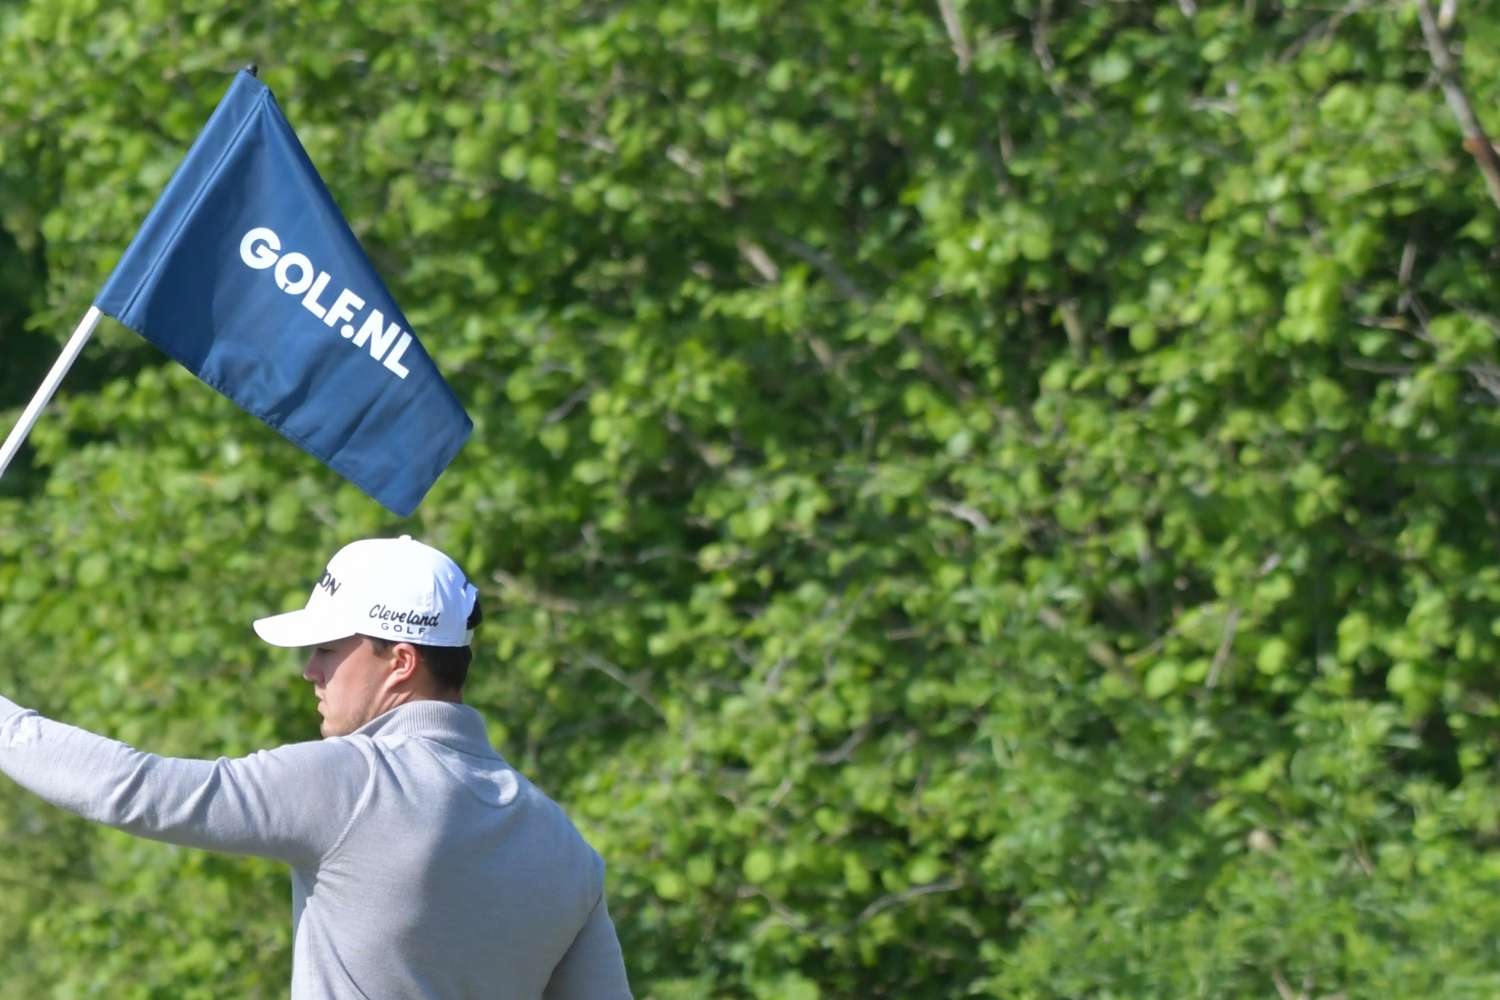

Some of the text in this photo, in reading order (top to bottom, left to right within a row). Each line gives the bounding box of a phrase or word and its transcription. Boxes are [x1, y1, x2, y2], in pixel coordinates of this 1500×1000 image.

[239, 227, 412, 379] GOLF.NL
[319, 570, 342, 597] ON
[369, 604, 441, 627] Cleveland
[381, 622, 426, 635] GOLF
